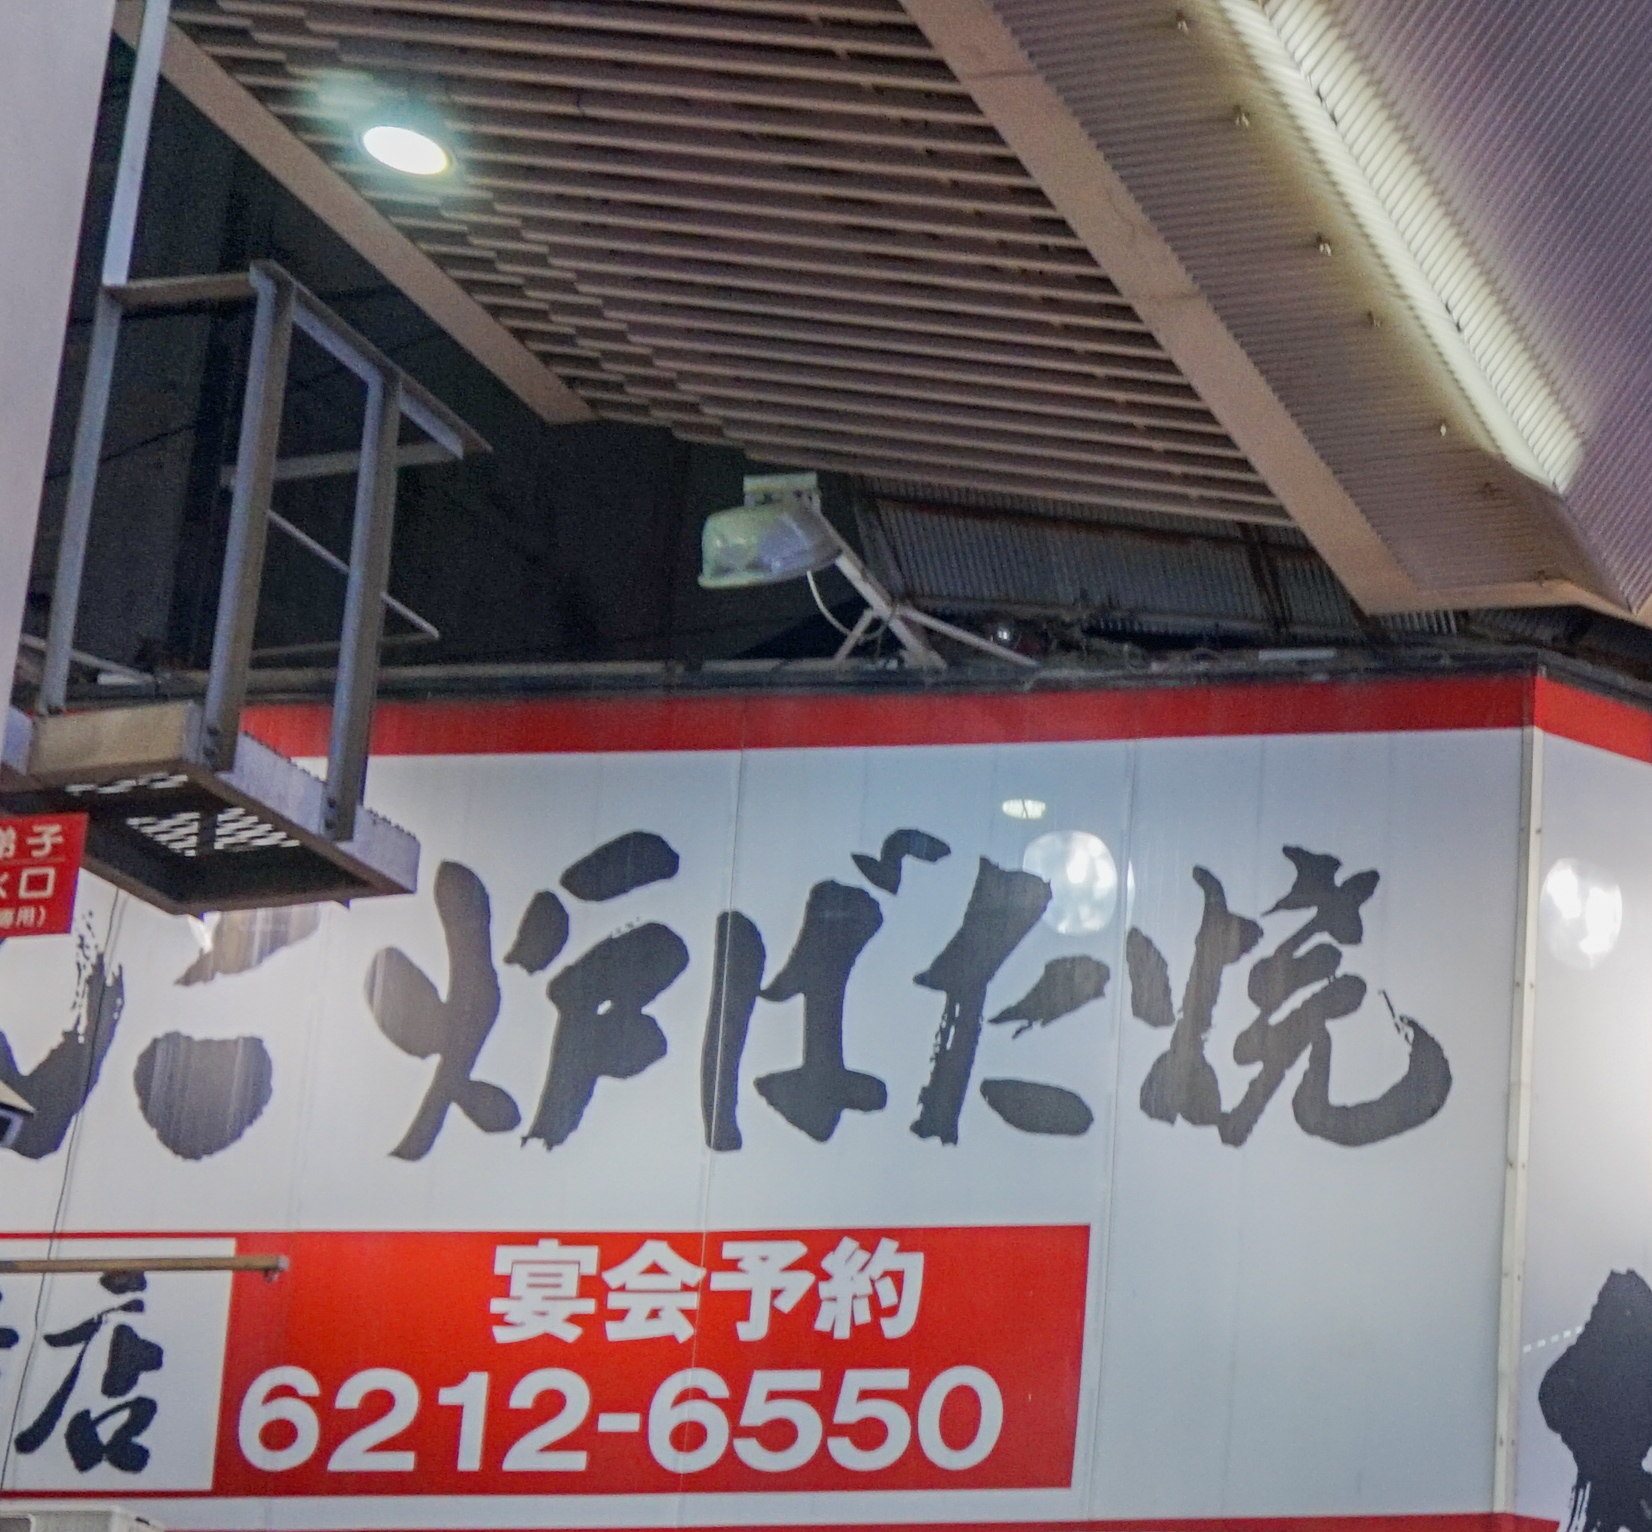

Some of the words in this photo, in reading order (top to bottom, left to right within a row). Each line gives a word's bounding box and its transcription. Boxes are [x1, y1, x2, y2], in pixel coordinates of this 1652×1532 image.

[364, 828, 1453, 1162] 炉ばた焼
[489, 1236, 925, 1344] 宴会予約
[236, 1363, 1004, 1473] 6212-6550
